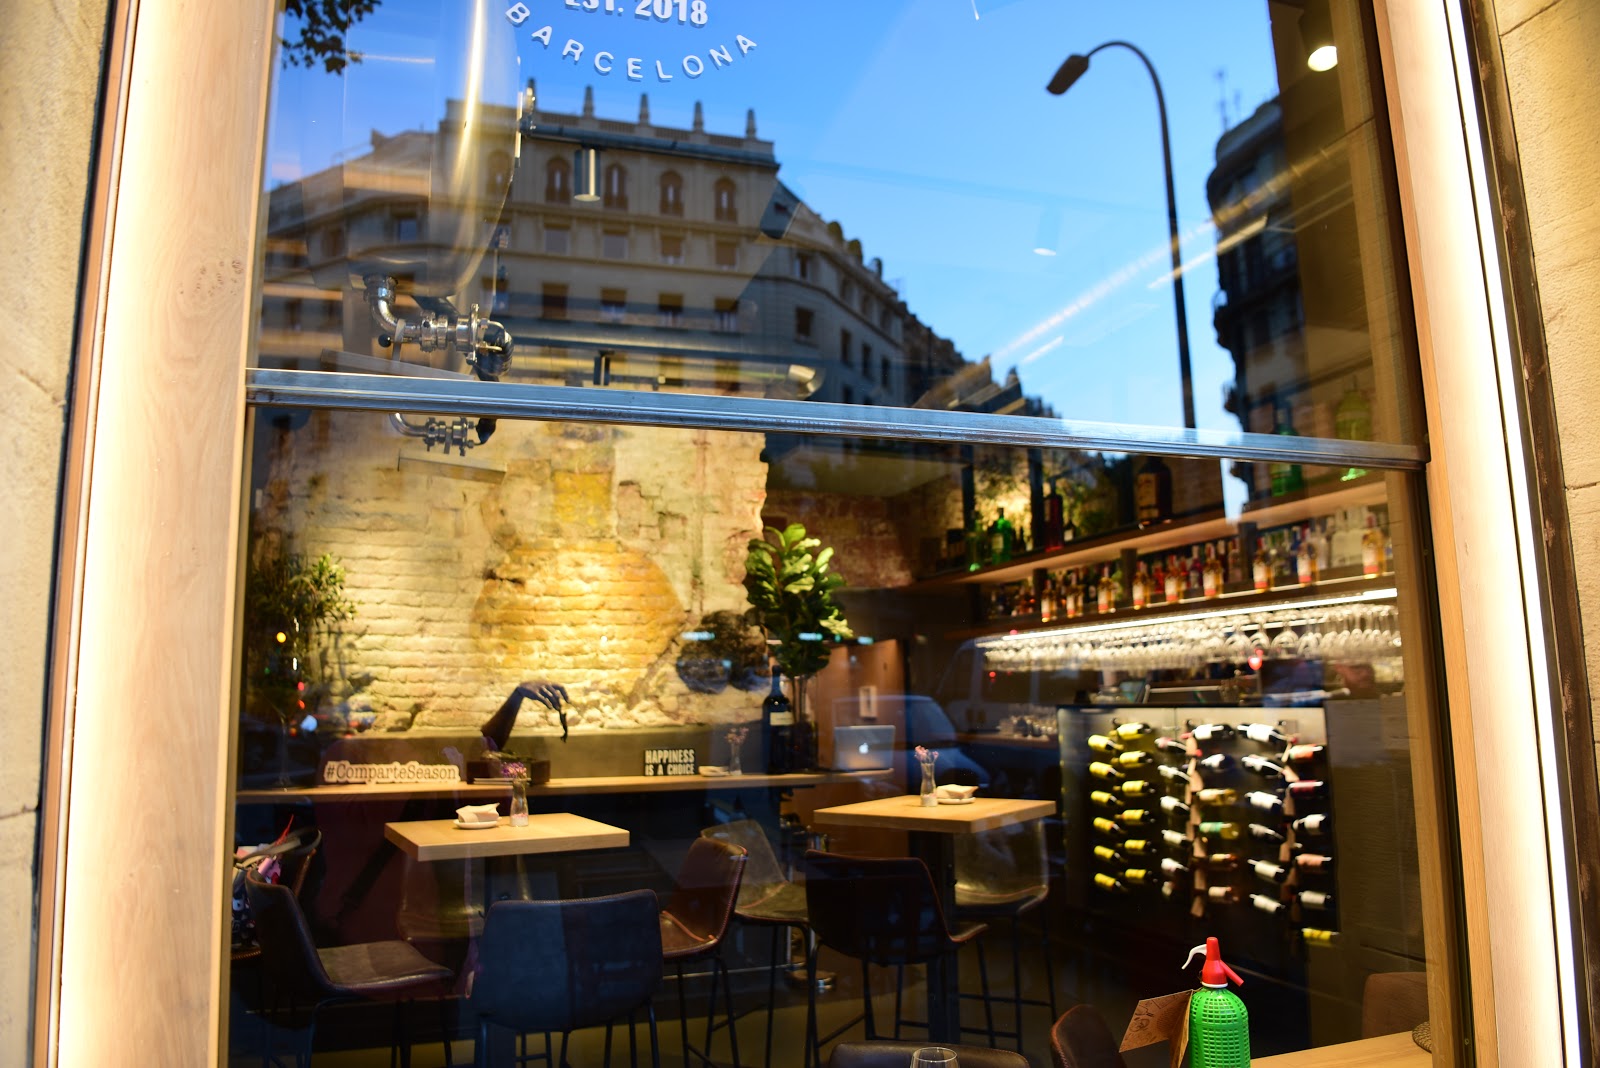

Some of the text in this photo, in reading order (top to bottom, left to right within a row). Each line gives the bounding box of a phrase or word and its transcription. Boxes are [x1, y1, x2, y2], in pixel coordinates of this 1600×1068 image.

[634, 0, 708, 25] 2018
[505, 2, 757, 79] BARCELONA
[645, 749, 695, 764] HAPPINESS
[326, 763, 456, 781] #ComparteSeason
[645, 763, 695, 776] IS A CHOICE
